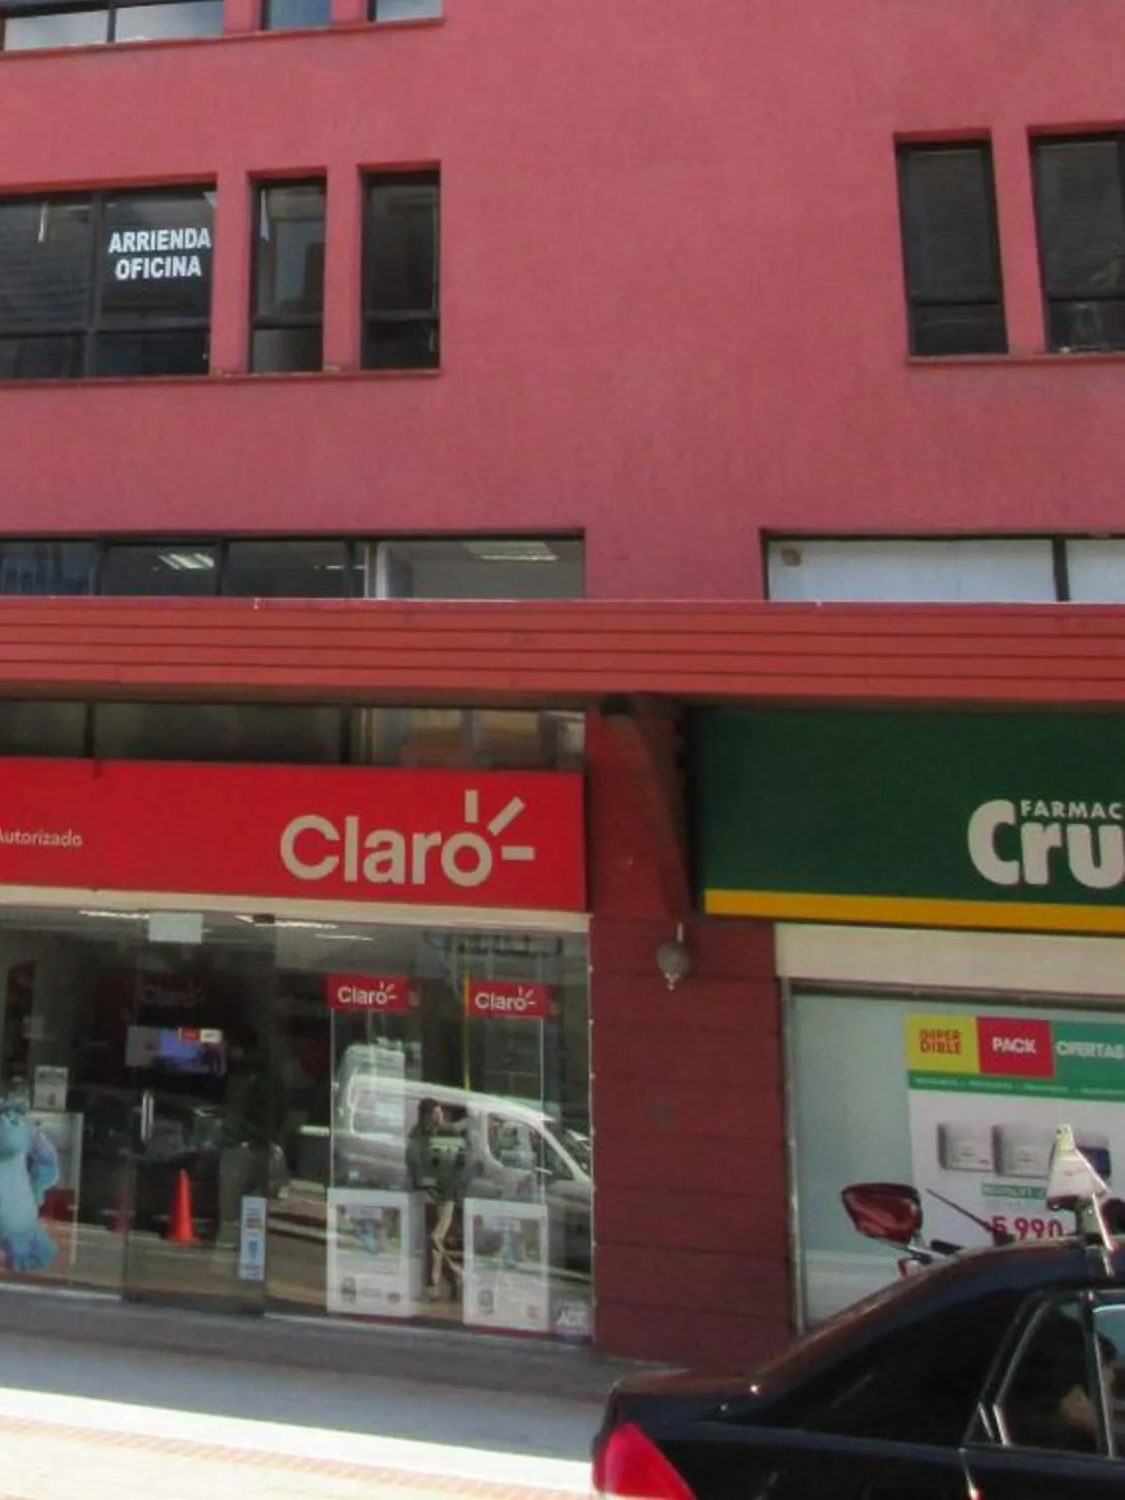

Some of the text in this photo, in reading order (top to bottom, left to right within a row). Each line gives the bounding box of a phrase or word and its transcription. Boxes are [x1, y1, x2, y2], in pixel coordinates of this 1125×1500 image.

[108, 227, 212, 254] ARRIENDA
[115, 255, 202, 280] OFICINA
[1020, 800, 1123, 820] FARMAC
[280, 812, 495, 887] Claro
[968, 799, 1125, 889] Cru
[337, 984, 389, 1006] Claro
[475, 991, 527, 1012] Claro
[992, 1036, 1037, 1055] PACK
